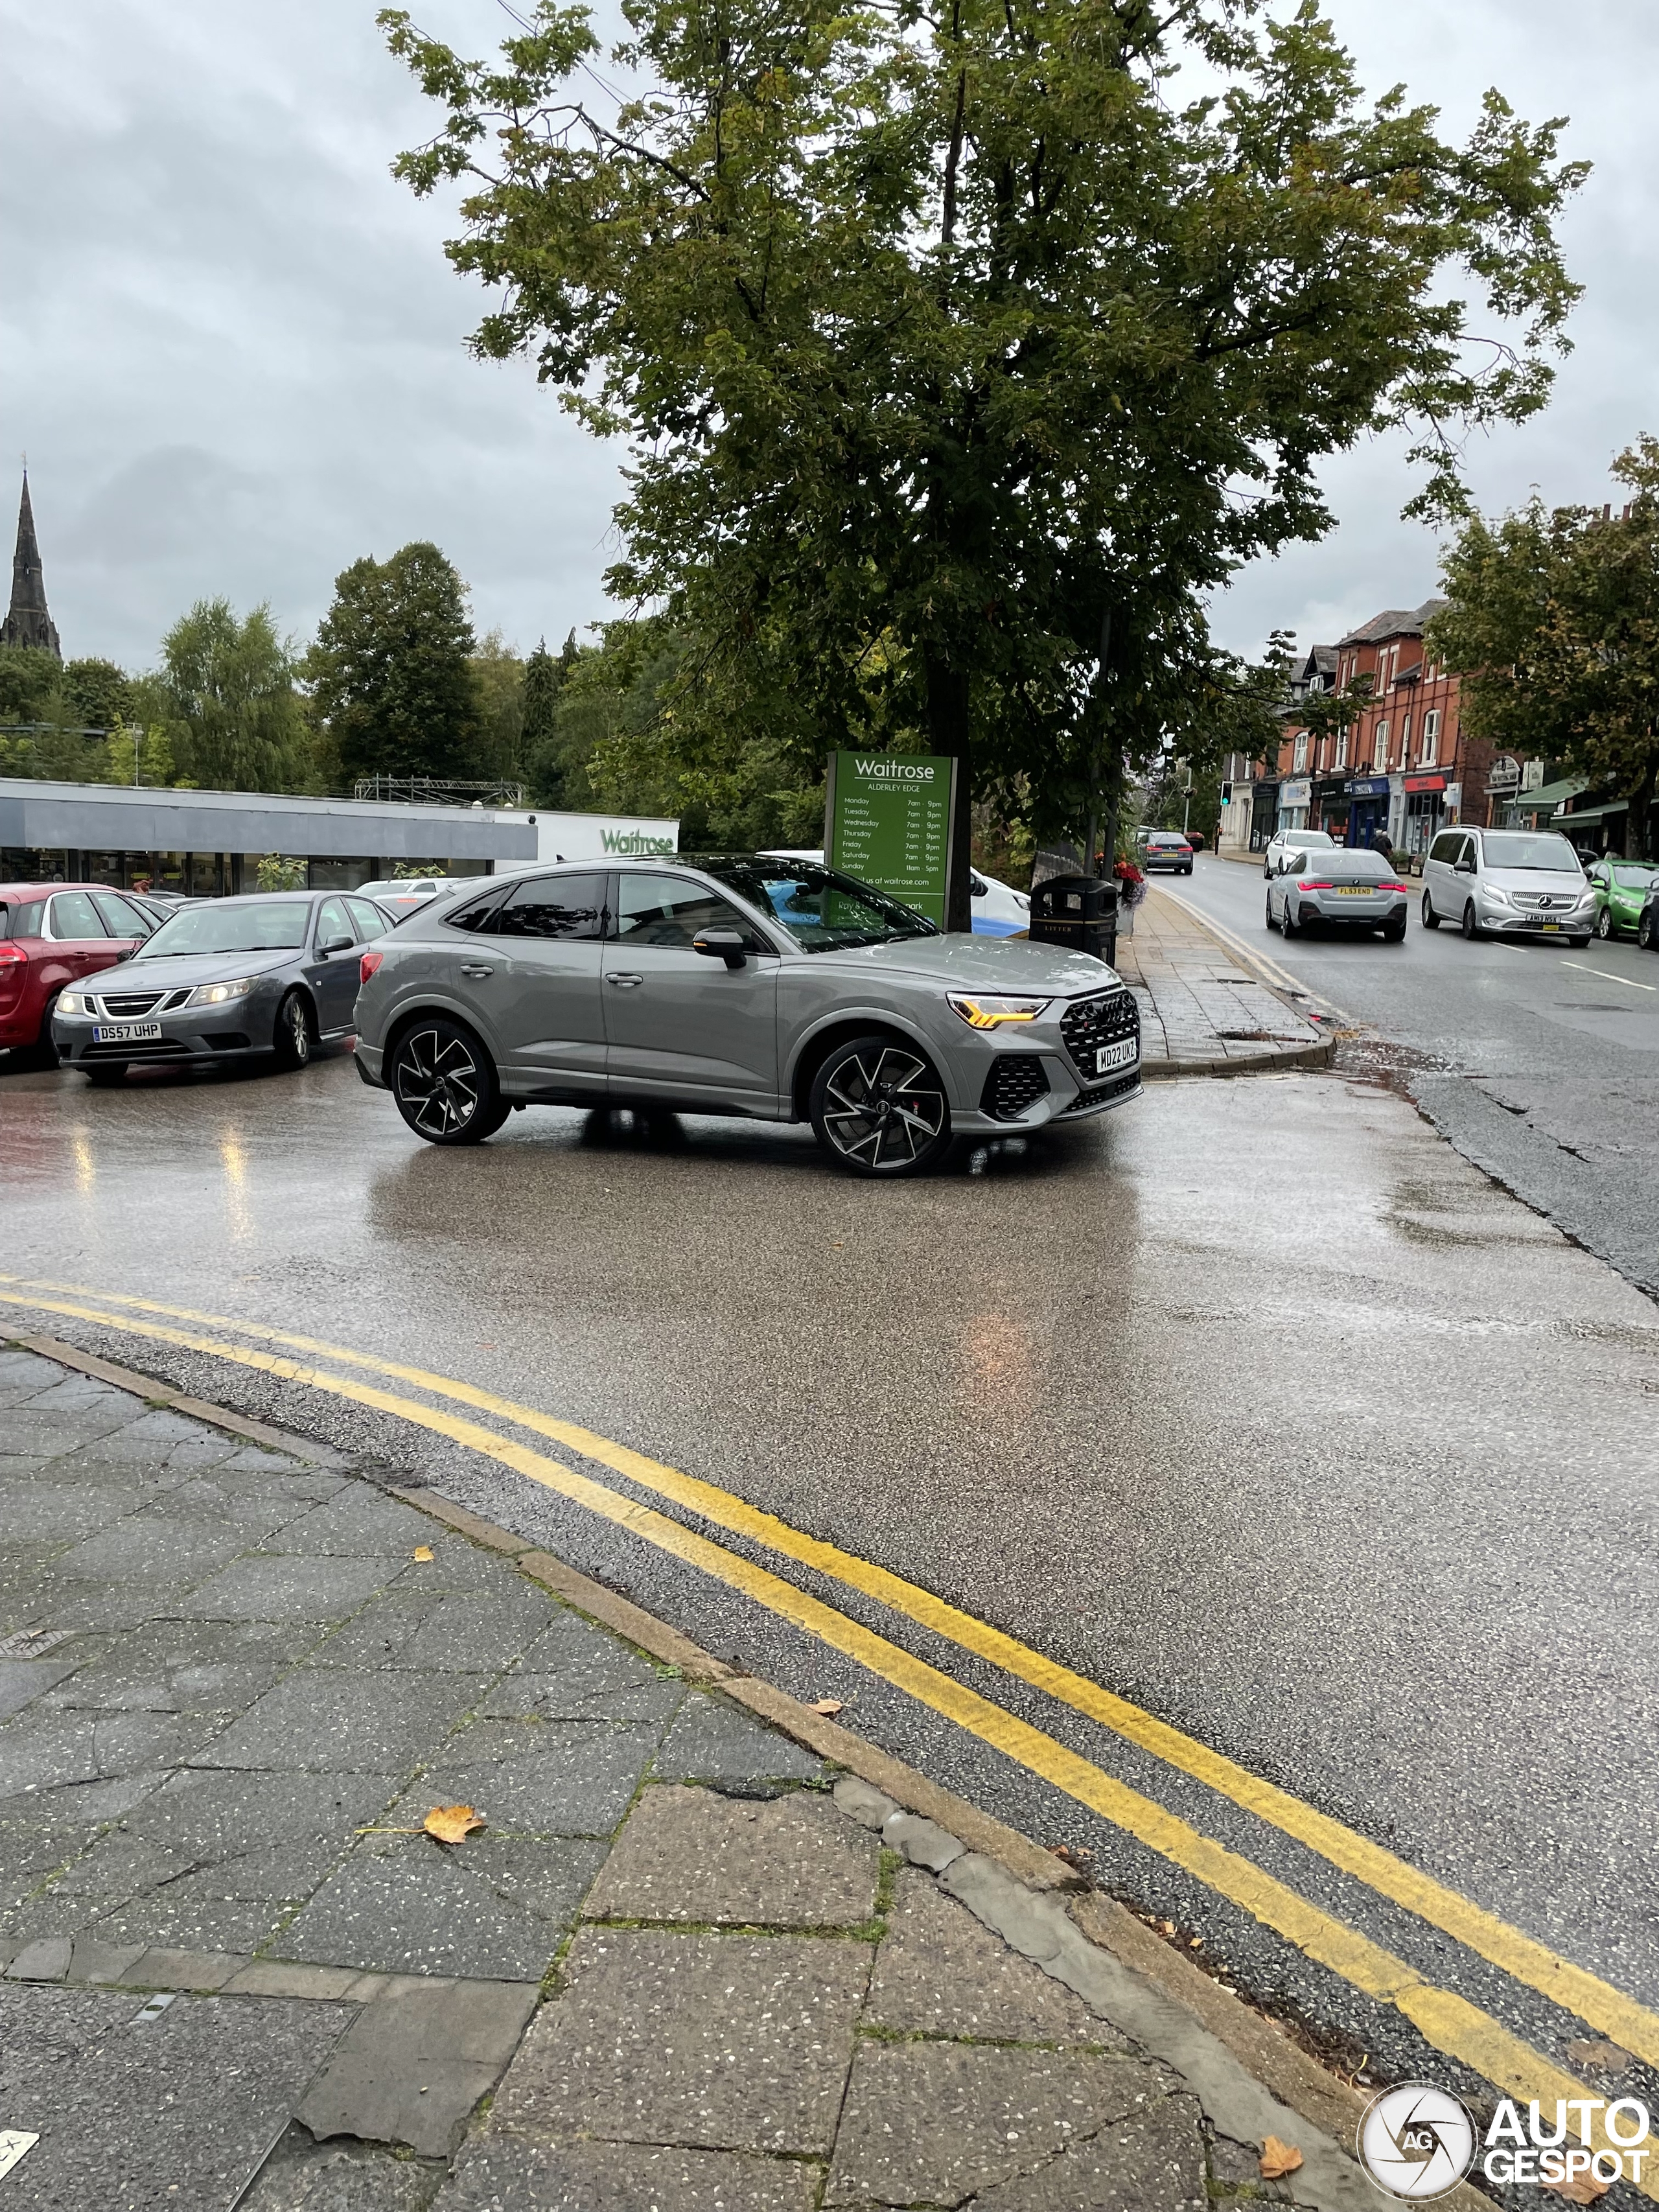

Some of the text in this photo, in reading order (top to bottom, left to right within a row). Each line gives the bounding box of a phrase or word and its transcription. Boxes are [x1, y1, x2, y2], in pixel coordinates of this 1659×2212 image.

[855, 759, 934, 778] Waitrose
[844, 797, 870, 806] Monday
[844, 808, 870, 817] Tuesday
[927, 811, 942, 819] 9pm
[844, 819, 879, 828] Wednesday
[843, 830, 872, 839] Thursday
[599, 828, 674, 854] Waitrose
[842, 841, 862, 849] Friday
[925, 843, 940, 852] 9pm
[842, 852, 870, 860] Saturday
[842, 862, 864, 871] Sunday
[883, 877, 929, 886] waitrose.com
[100, 1026, 130, 1039] DS57
[134, 1024, 157, 1036] UHP
[1101, 1041, 1134, 1069] MD22 UKZ
